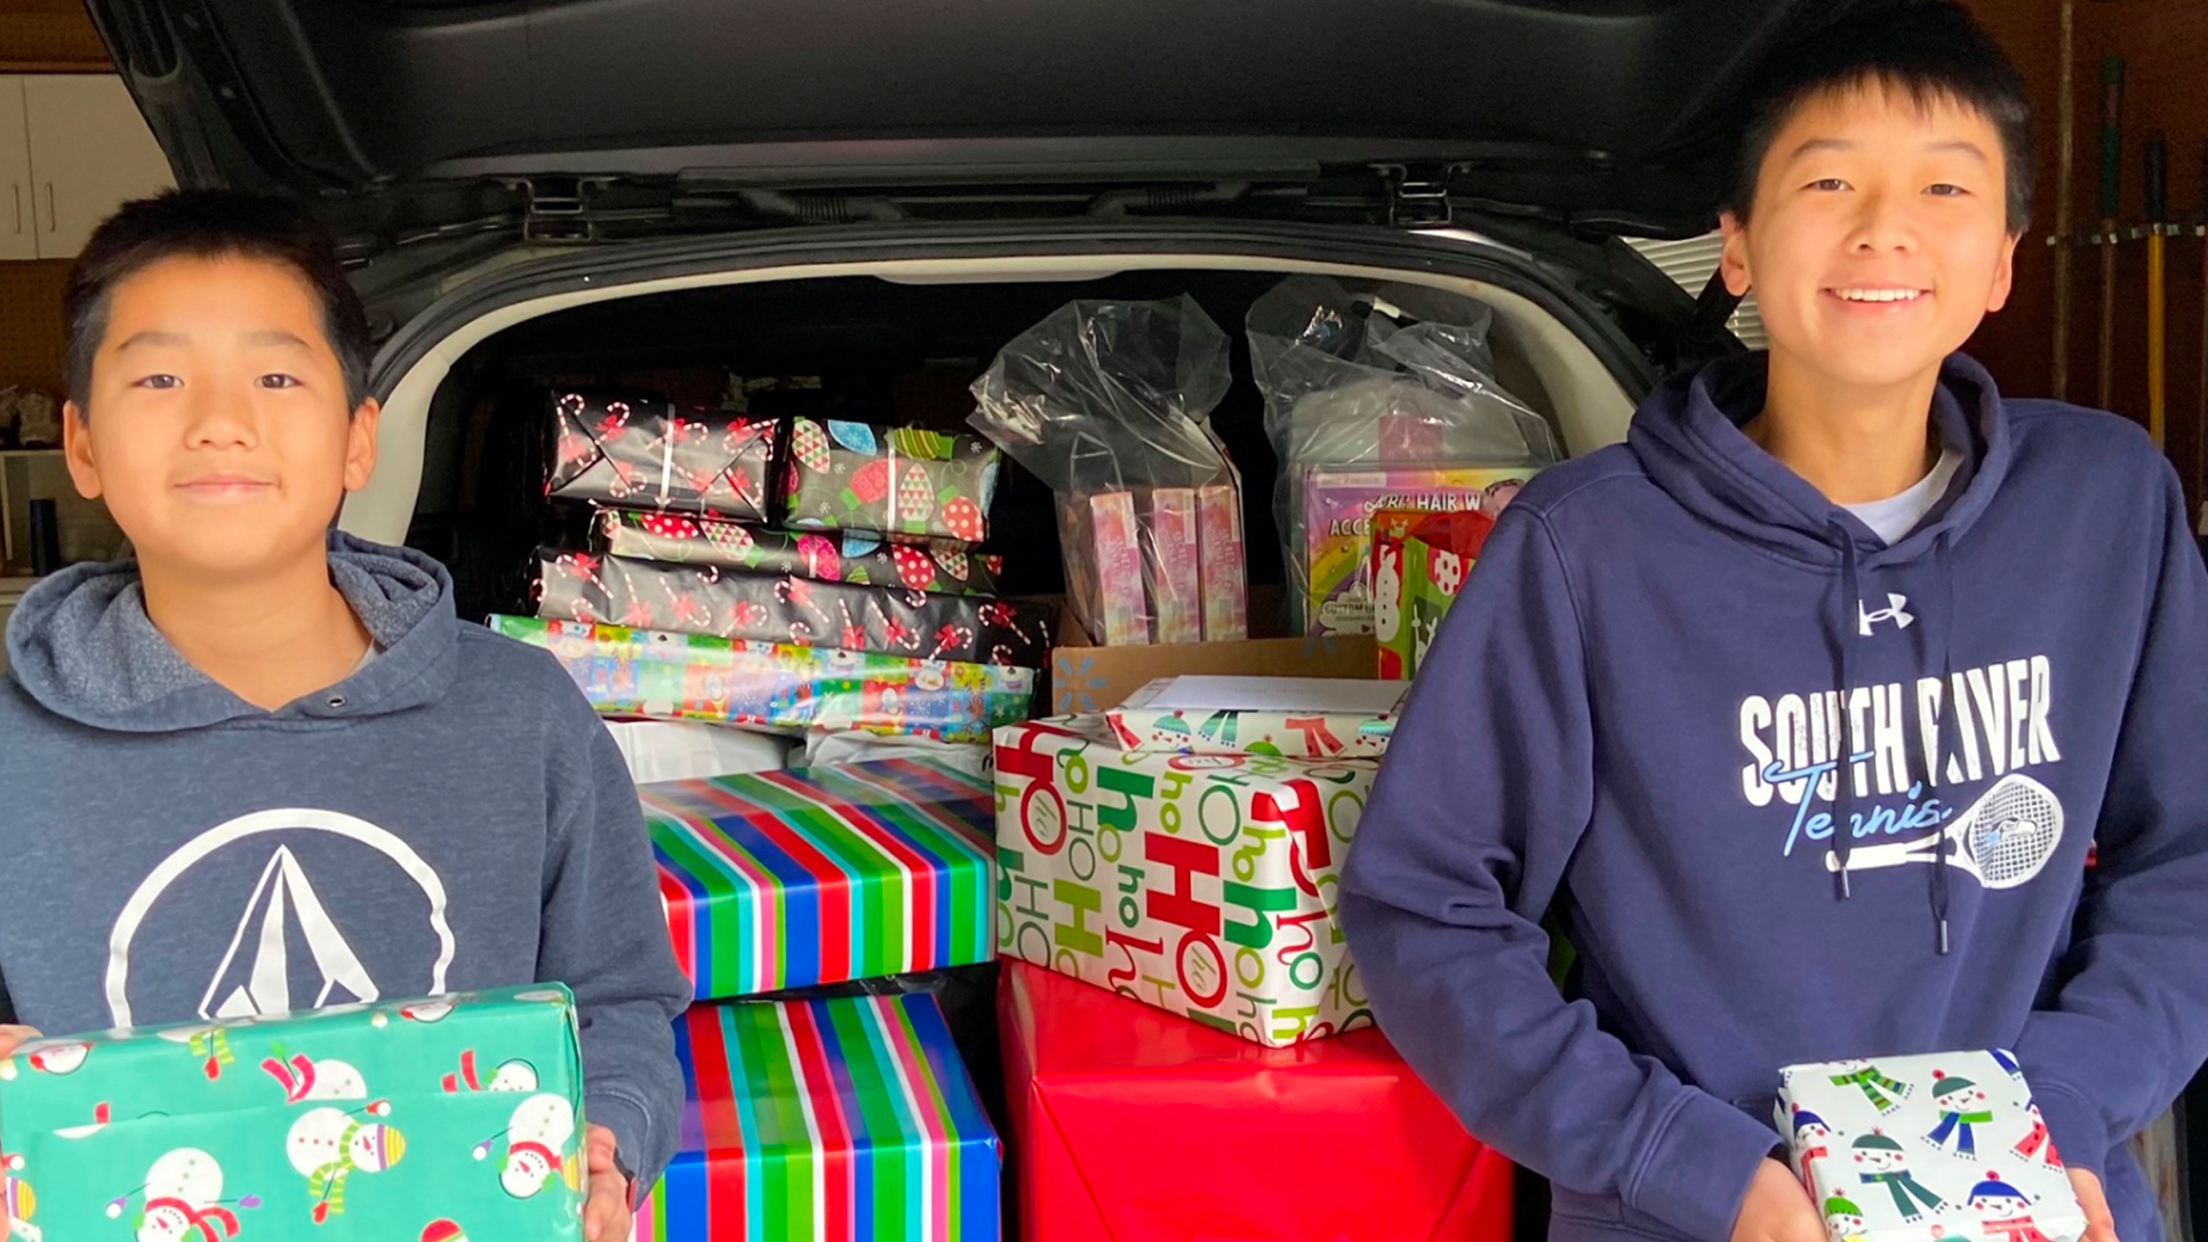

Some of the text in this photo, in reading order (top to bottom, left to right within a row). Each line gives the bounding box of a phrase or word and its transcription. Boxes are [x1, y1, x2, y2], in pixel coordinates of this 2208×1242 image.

[1330, 518, 1371, 536] ACCE
[1416, 493, 1458, 511] HAIR
[1740, 683, 1909, 807] SOUTH
[1066, 799, 1096, 881] HO
[1097, 765, 1155, 863] ho
[1160, 771, 1194, 834] ho
[1762, 751, 1953, 857] Tennis
[1232, 825, 1286, 882] ho
[1117, 864, 1146, 929] ho
[1144, 831, 1228, 1009] HO
[1223, 880, 1297, 989] ho
